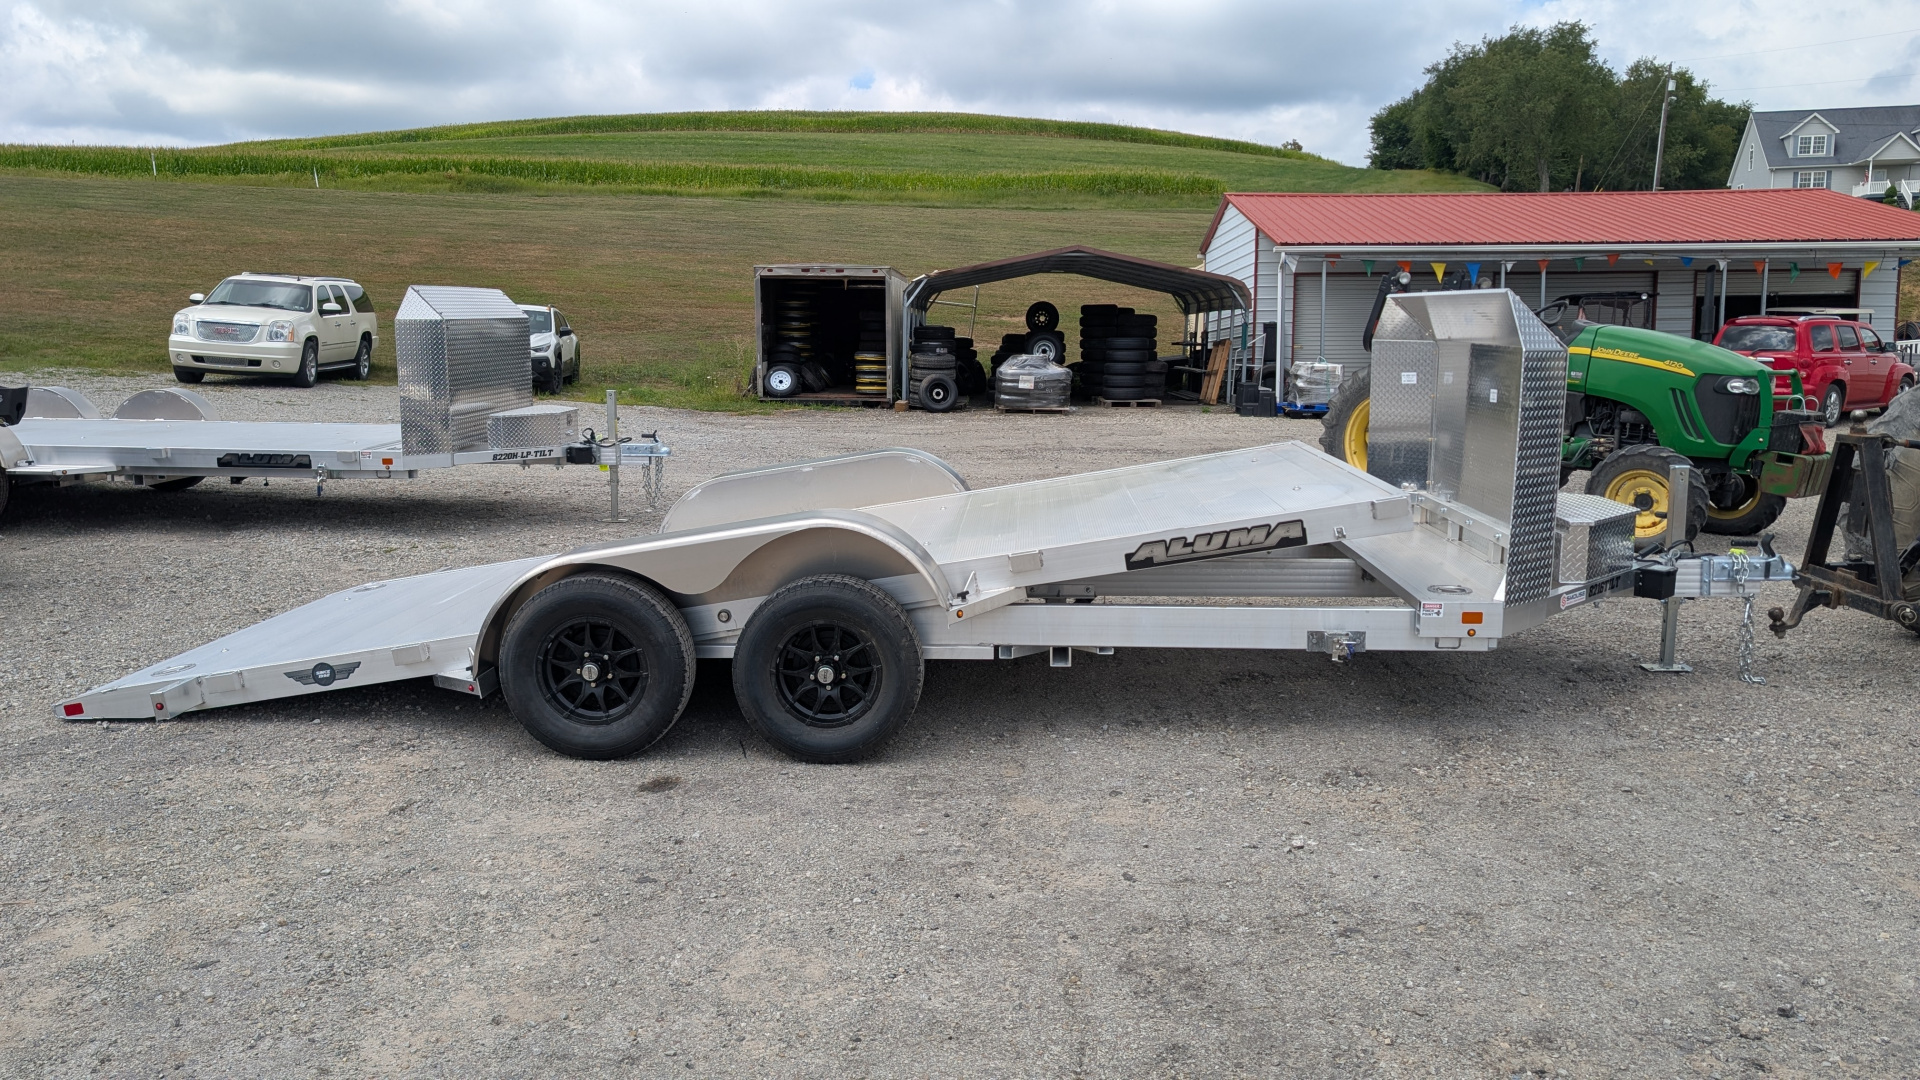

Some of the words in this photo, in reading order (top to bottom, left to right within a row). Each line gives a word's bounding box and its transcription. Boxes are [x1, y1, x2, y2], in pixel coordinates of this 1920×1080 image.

[1594, 346, 1614, 355] JOHN
[1613, 348, 1640, 359] DEERE
[1663, 359, 1684, 369] 4120
[219, 453, 310, 467] ALUMA
[492, 449, 554, 461] 8220H-LP-TILT
[1127, 519, 1304, 566] ALUMA
[1566, 590, 1586, 601] SMOUSE
